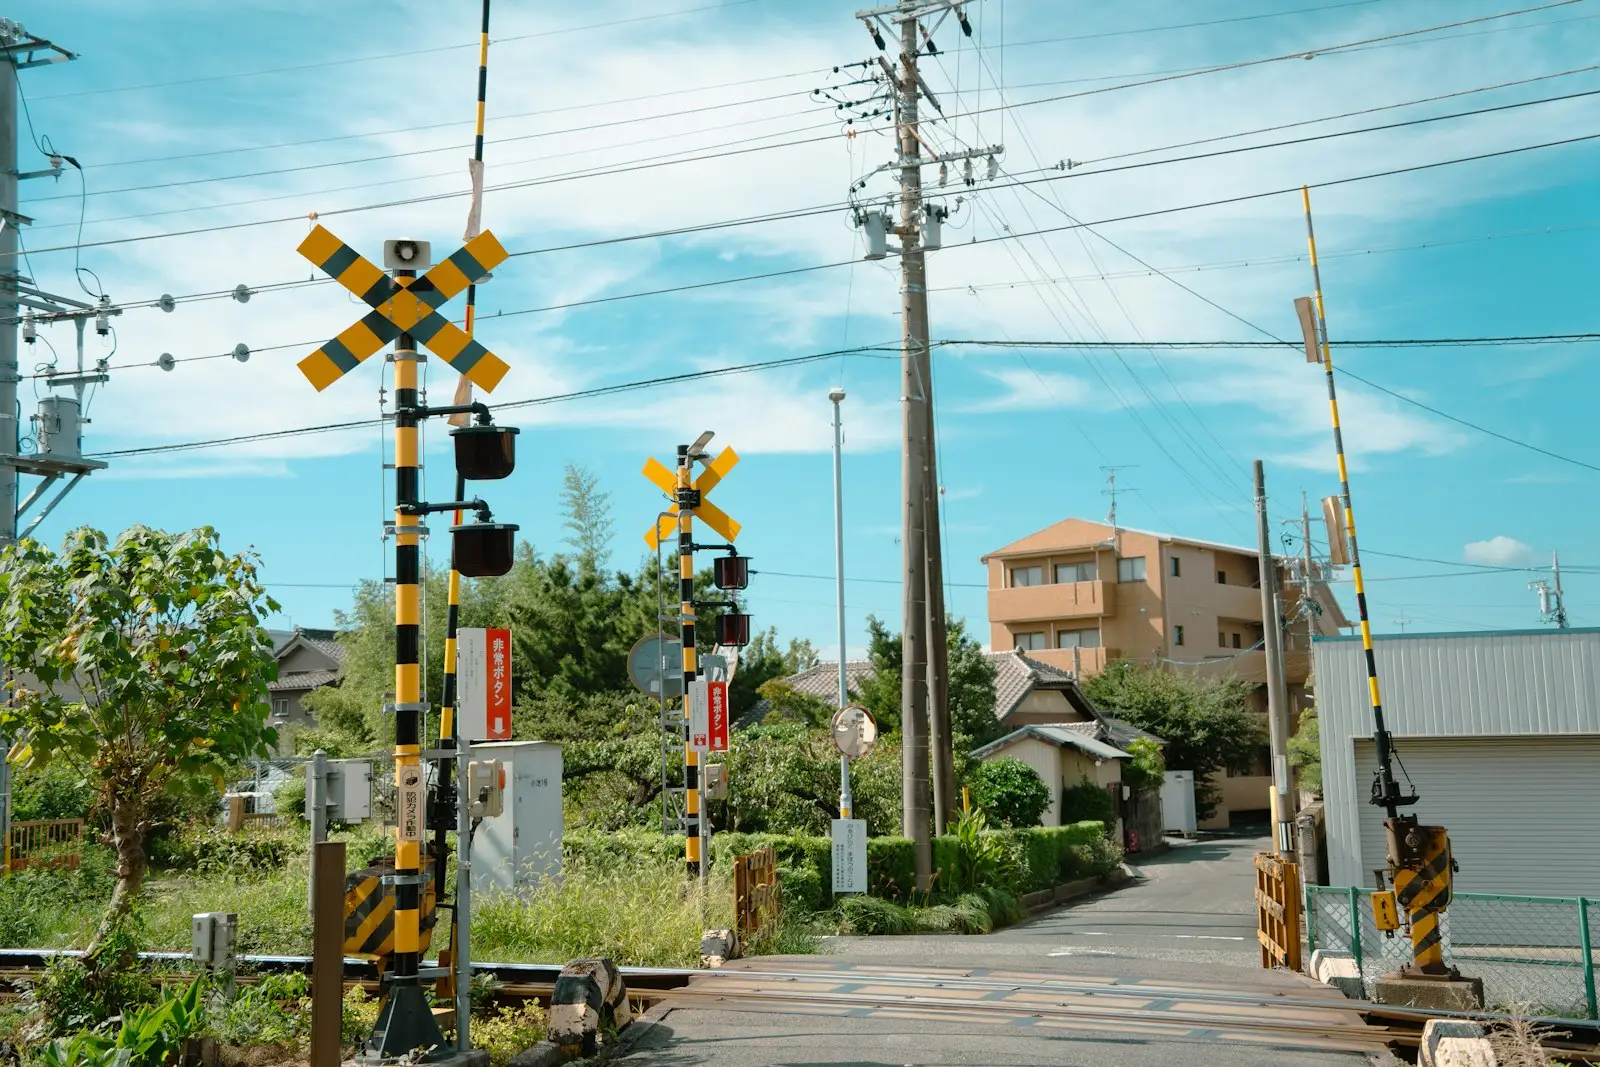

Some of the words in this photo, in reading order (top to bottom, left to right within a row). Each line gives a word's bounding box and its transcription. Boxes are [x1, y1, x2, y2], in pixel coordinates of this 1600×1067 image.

[493, 638, 504, 706] 非常ボタン
[712, 687, 722, 730] 非常ボタン
[406, 791, 416, 837] 防犯カメラ作動中
